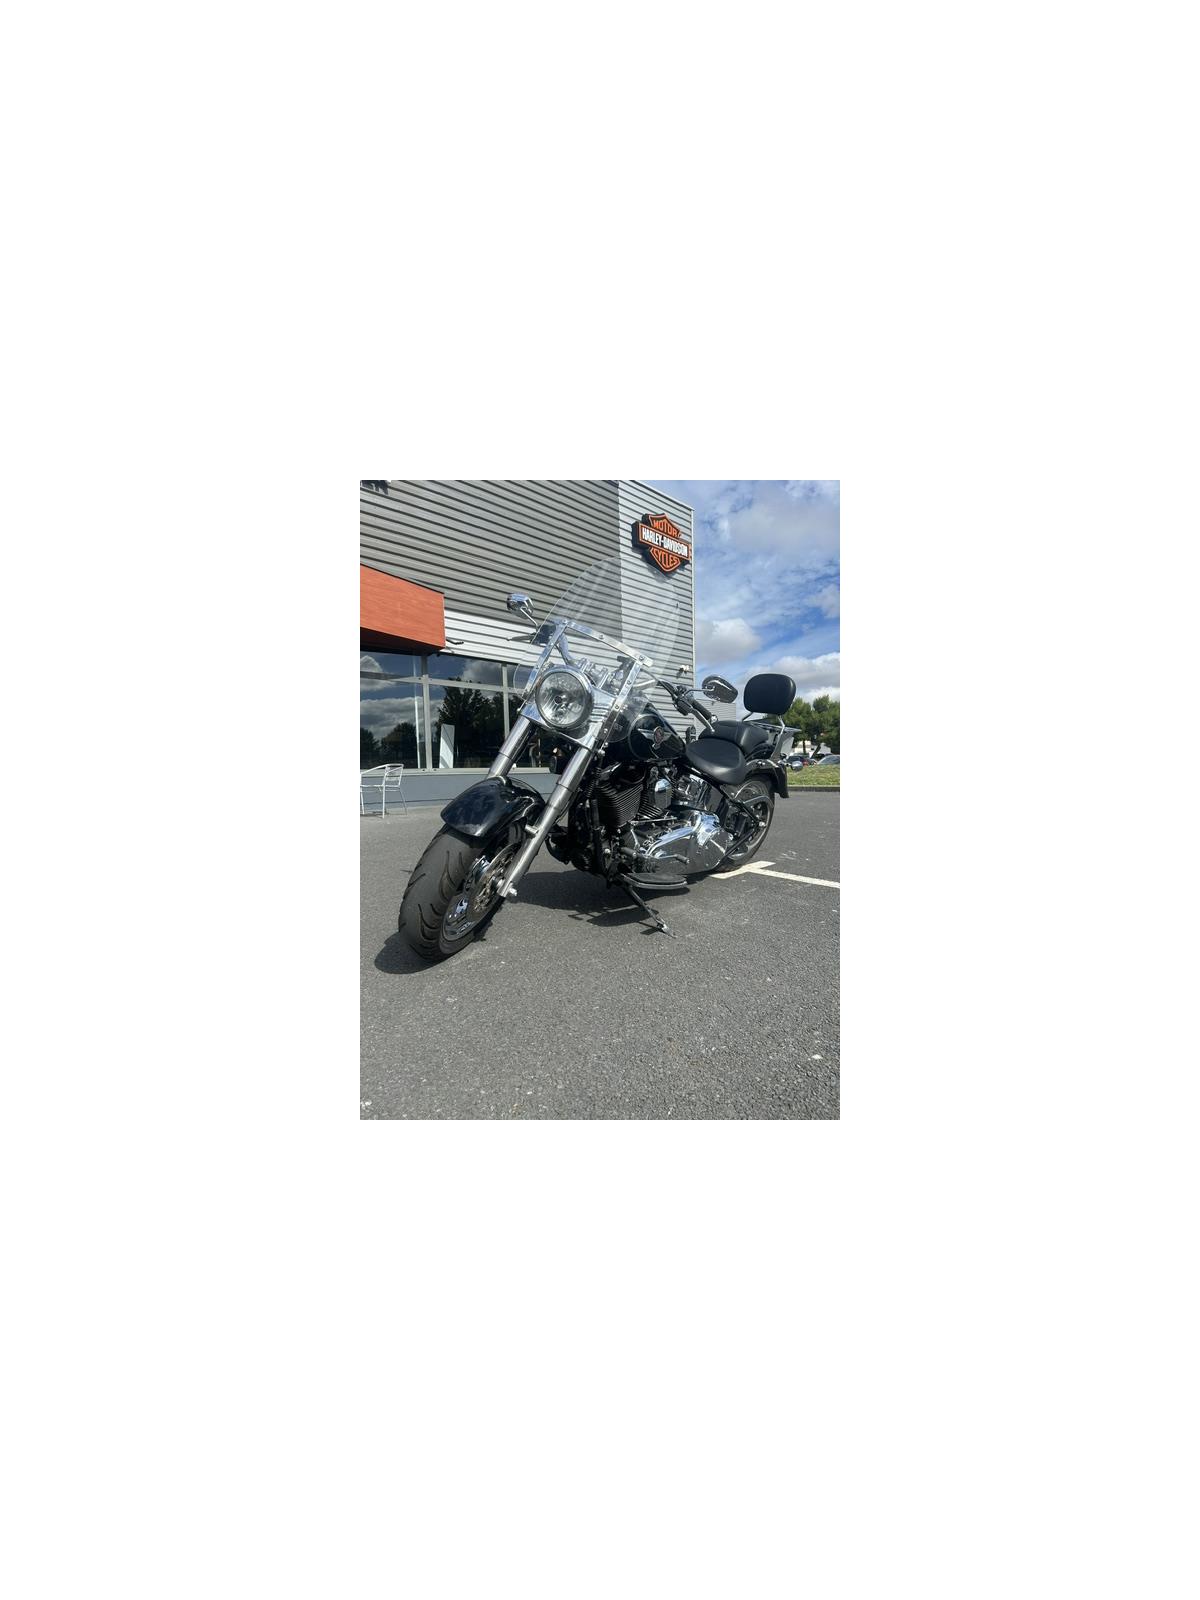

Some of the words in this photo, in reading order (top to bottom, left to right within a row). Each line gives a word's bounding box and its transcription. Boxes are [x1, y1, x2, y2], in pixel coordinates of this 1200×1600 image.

[653, 519, 679, 537] MOTOR
[642, 526, 688, 557] HARLEY-DAVIDSON
[653, 548, 680, 568] CYCLES
